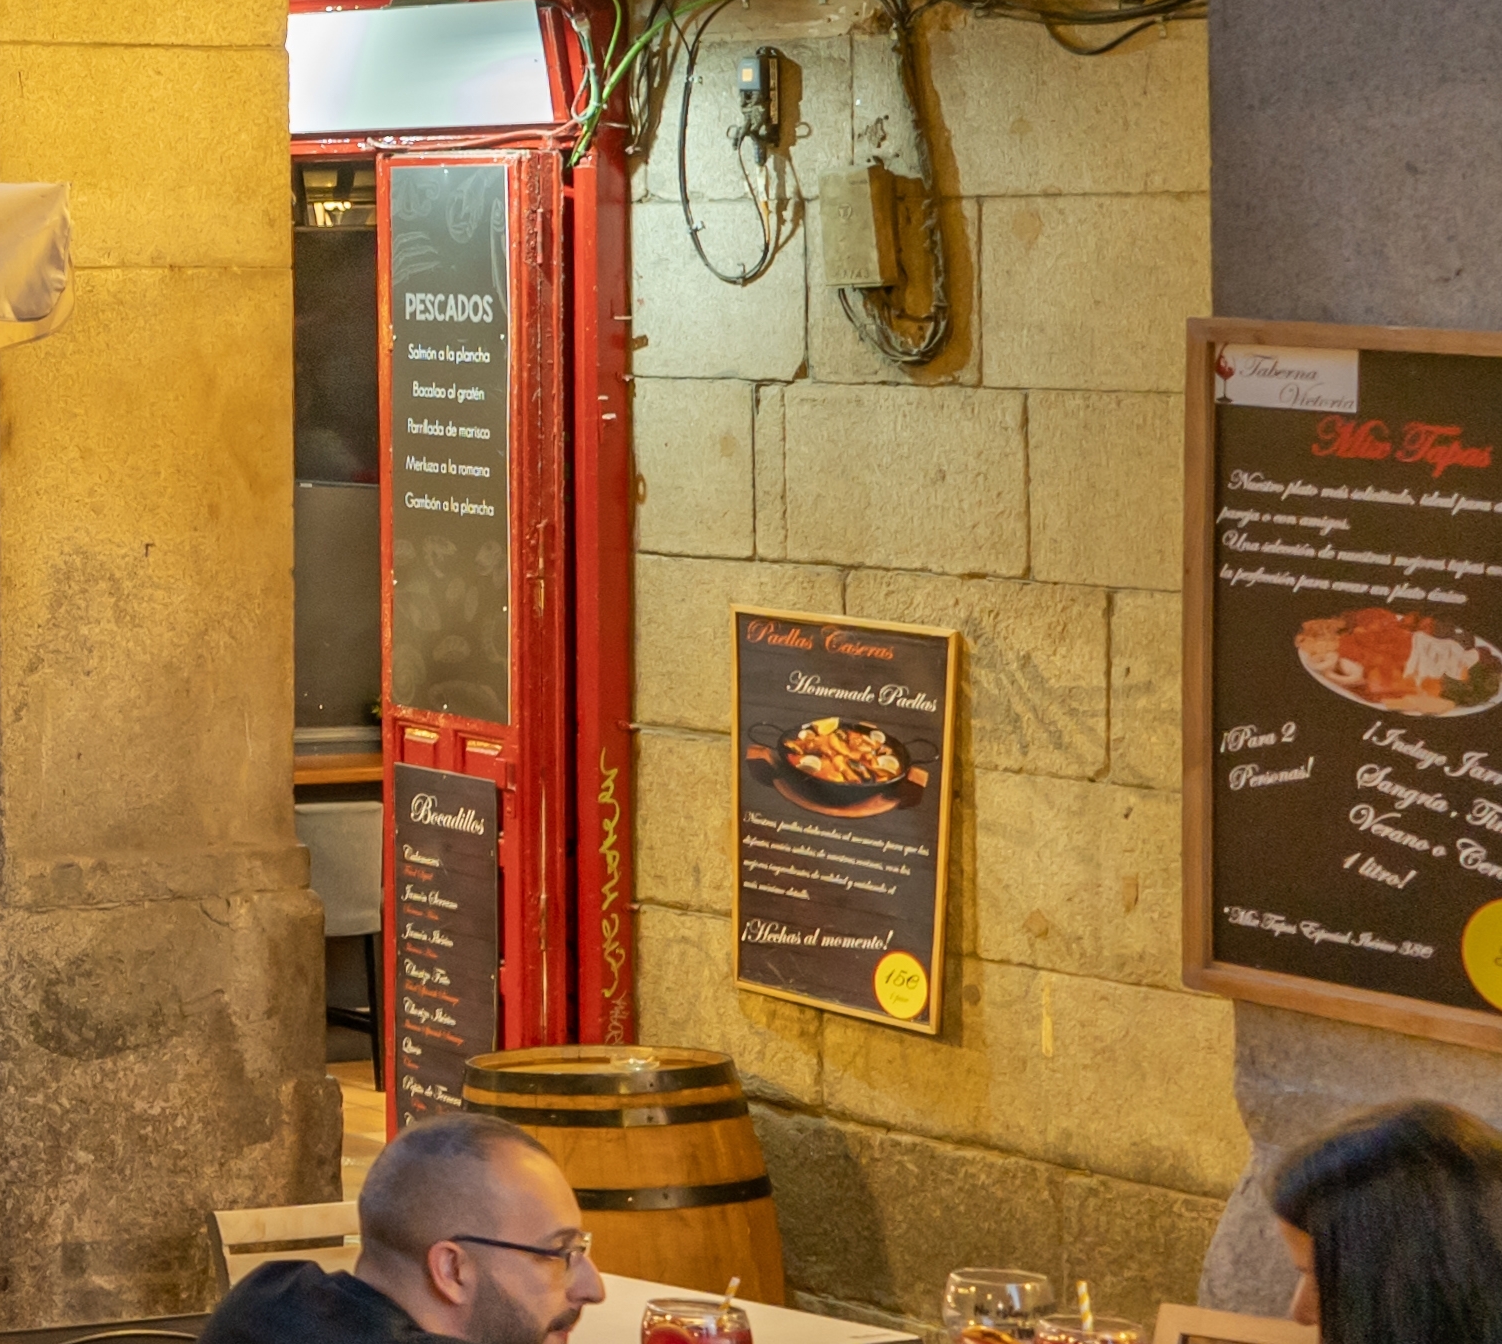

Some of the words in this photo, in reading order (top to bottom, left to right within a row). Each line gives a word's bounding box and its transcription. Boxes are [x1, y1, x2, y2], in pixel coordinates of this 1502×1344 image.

[405, 293, 493, 323] PESCADOS
[408, 343, 436, 360] Salmón
[438, 348, 444, 360] a
[446, 345, 455, 361] la
[456, 346, 490, 364] plancha
[1239, 352, 1318, 380] Taberna
[412, 381, 446, 398] Bacalao
[448, 382, 455, 399] al
[1279, 382, 1355, 409] Victoria
[407, 418, 444, 436] Parrillada
[446, 421, 457, 436] de
[459, 424, 490, 439] marisco
[405, 456, 439, 473] Merluza
[441, 461, 447, 473] a
[448, 459, 457, 474] la
[458, 463, 490, 477] romana
[405, 492, 441, 510] Gambón
[443, 499, 449, 511] a
[450, 497, 459, 513] la
[461, 498, 494, 516] plancha
[746, 619, 814, 650] Paellas
[821, 625, 894, 660] Caseras
[786, 670, 875, 703] Homemade
[878, 683, 938, 712] Paellas
[1281, 721, 1298, 744] 2
[1229, 757, 1315, 791] Personas!
[410, 793, 485, 836] Bocadillos
[1349, 804, 1430, 851] Verano
[1432, 845, 1446, 856] o
[1343, 852, 1362, 868] 1
[1358, 857, 1417, 888] litro!
[741, 918, 801, 944] ¡Hechas
[804, 928, 820, 945] al
[821, 930, 894, 951] momento!
